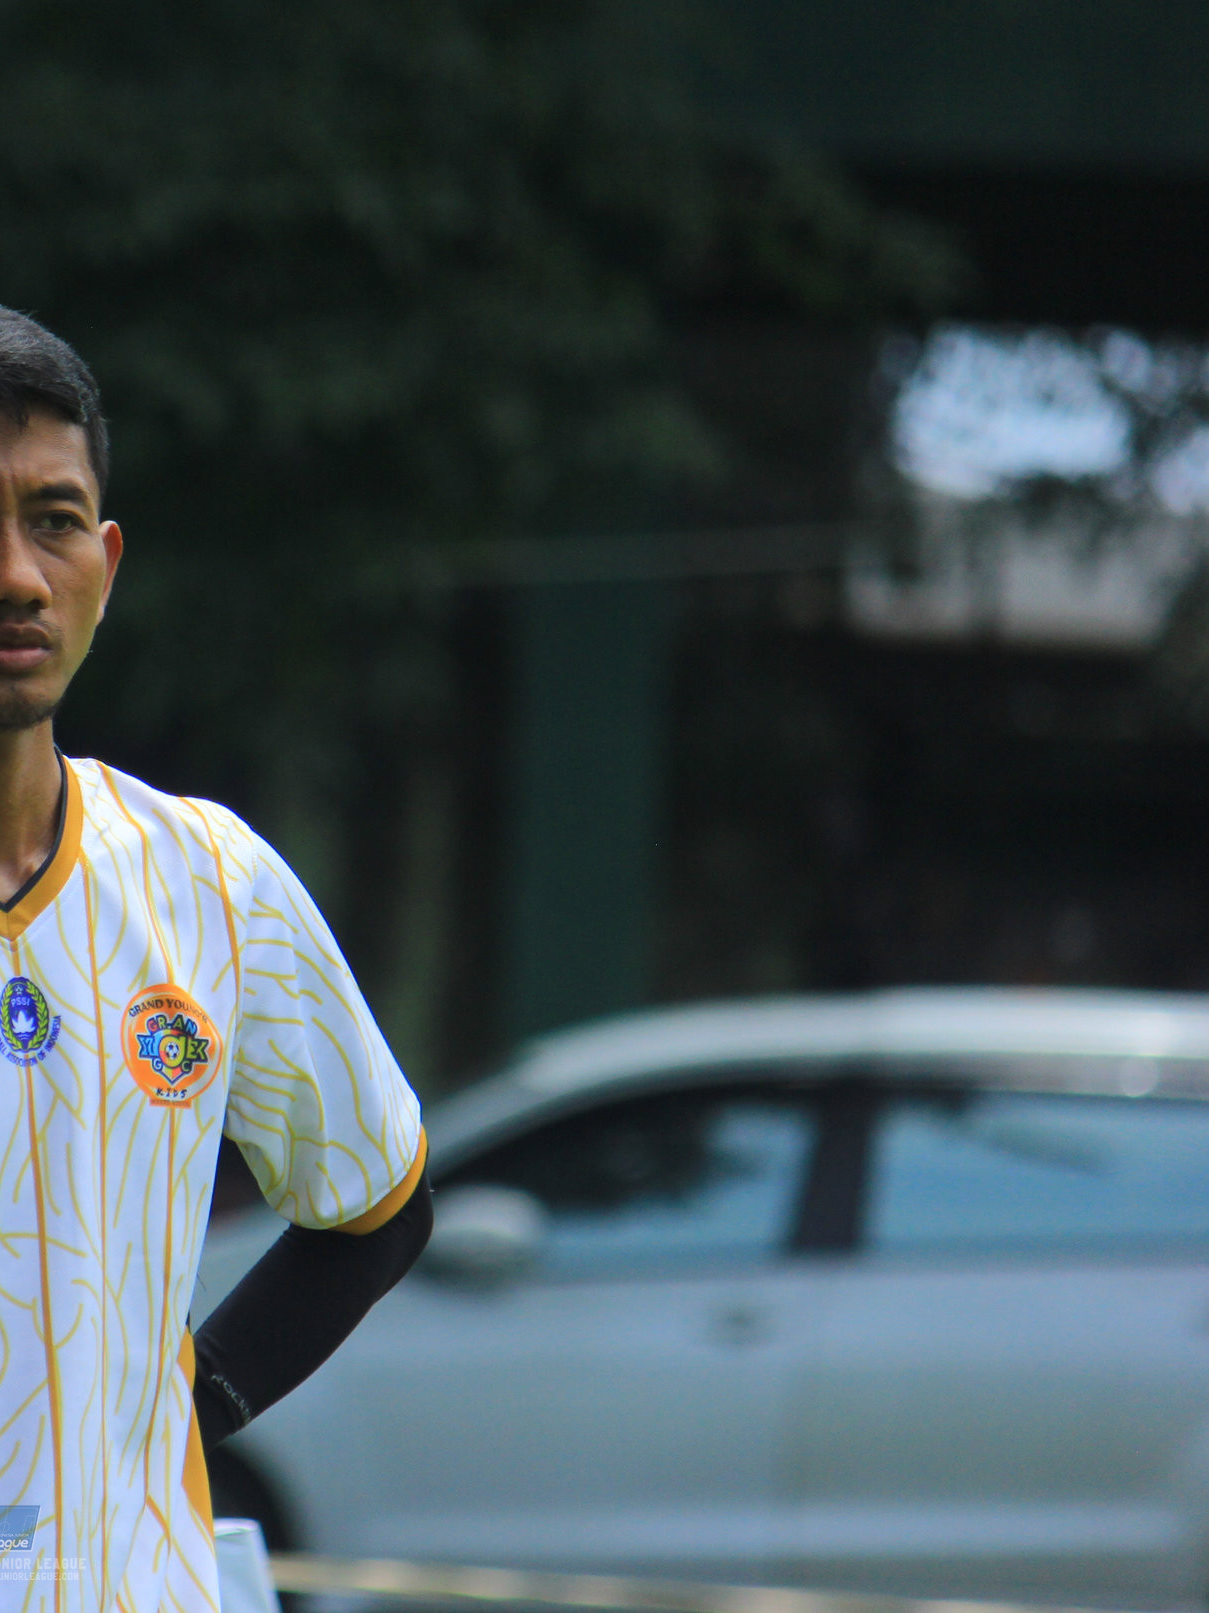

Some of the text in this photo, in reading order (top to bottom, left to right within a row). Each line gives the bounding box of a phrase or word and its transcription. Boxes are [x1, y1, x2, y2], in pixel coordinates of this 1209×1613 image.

[11, 997, 30, 1007] PSSI
[128, 999, 164, 1017] GRAND
[155, 1087, 188, 1098] KIDS
